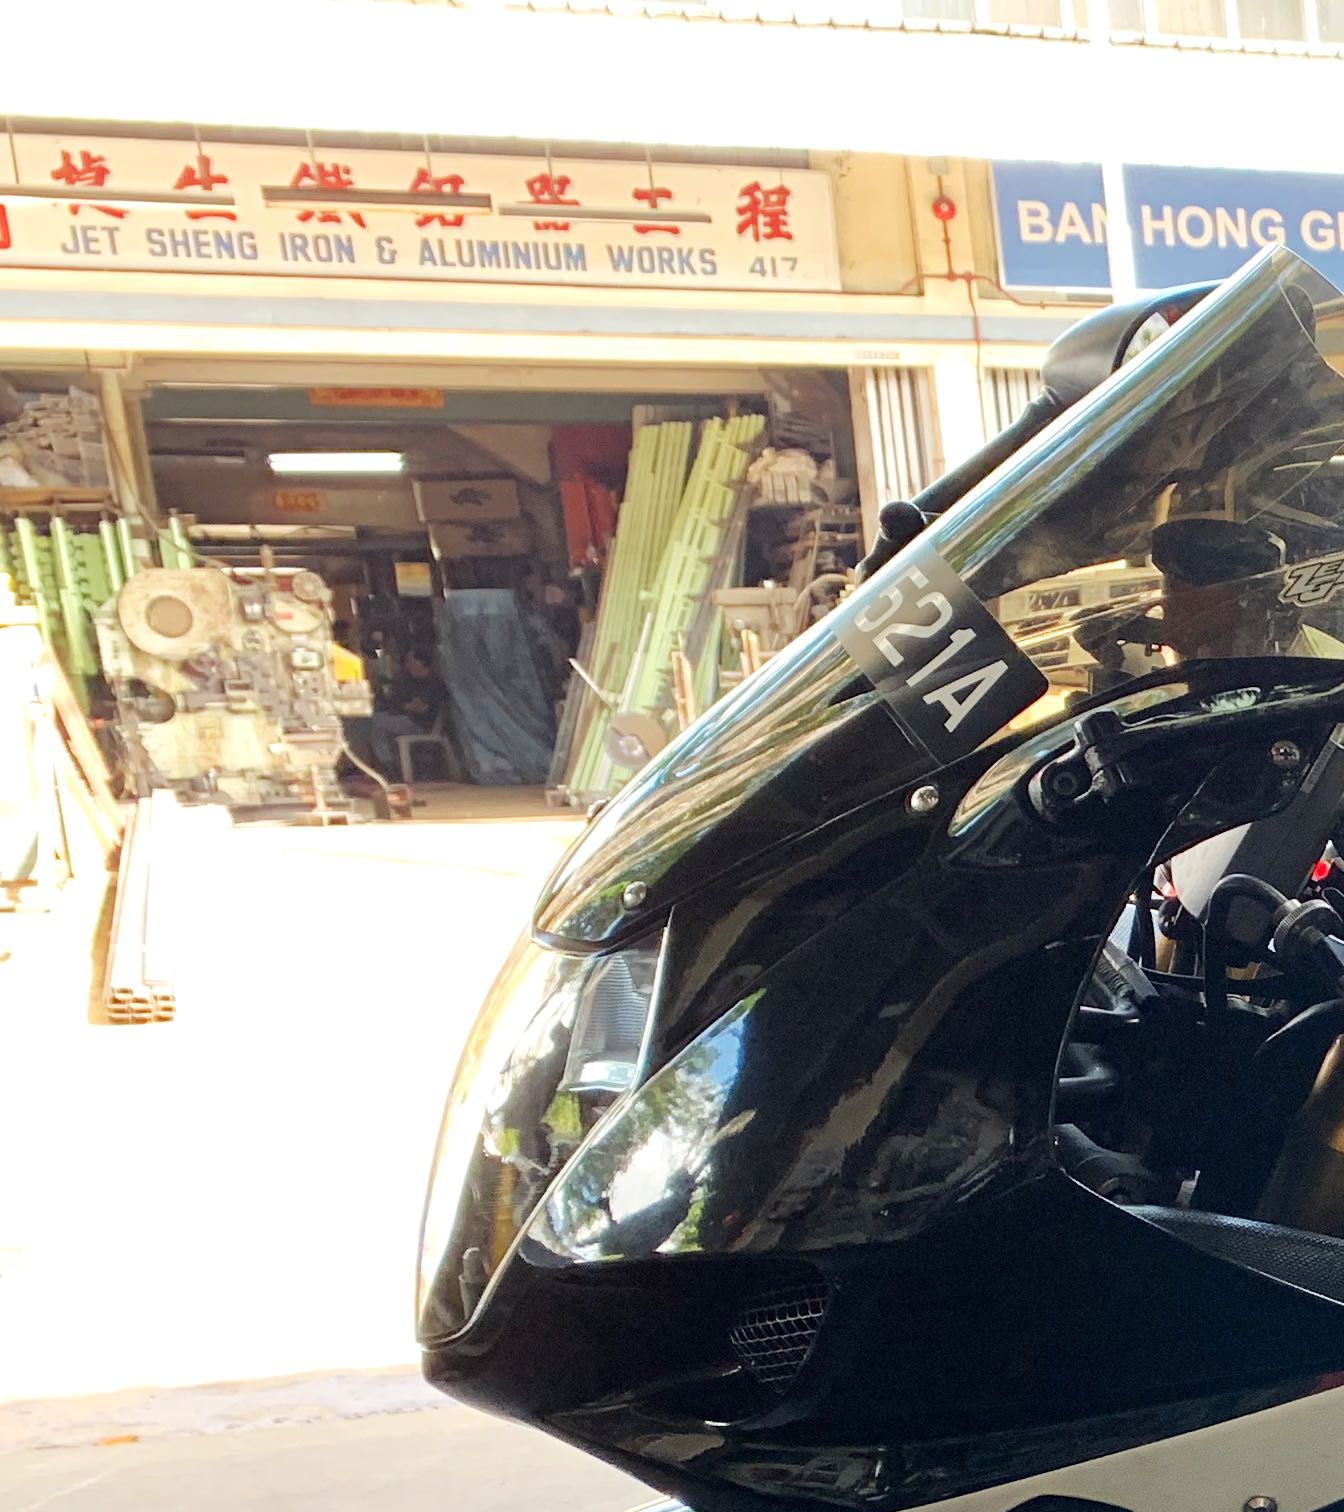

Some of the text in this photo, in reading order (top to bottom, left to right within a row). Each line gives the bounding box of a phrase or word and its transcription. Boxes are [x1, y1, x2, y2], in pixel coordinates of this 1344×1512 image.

[60, 225, 719, 276] JET SHENG IRON & ALUMINIUM WORKS
[1141, 205, 1287, 249] HONG
[748, 256, 799, 279] 417
[854, 566, 1009, 733] 521A
